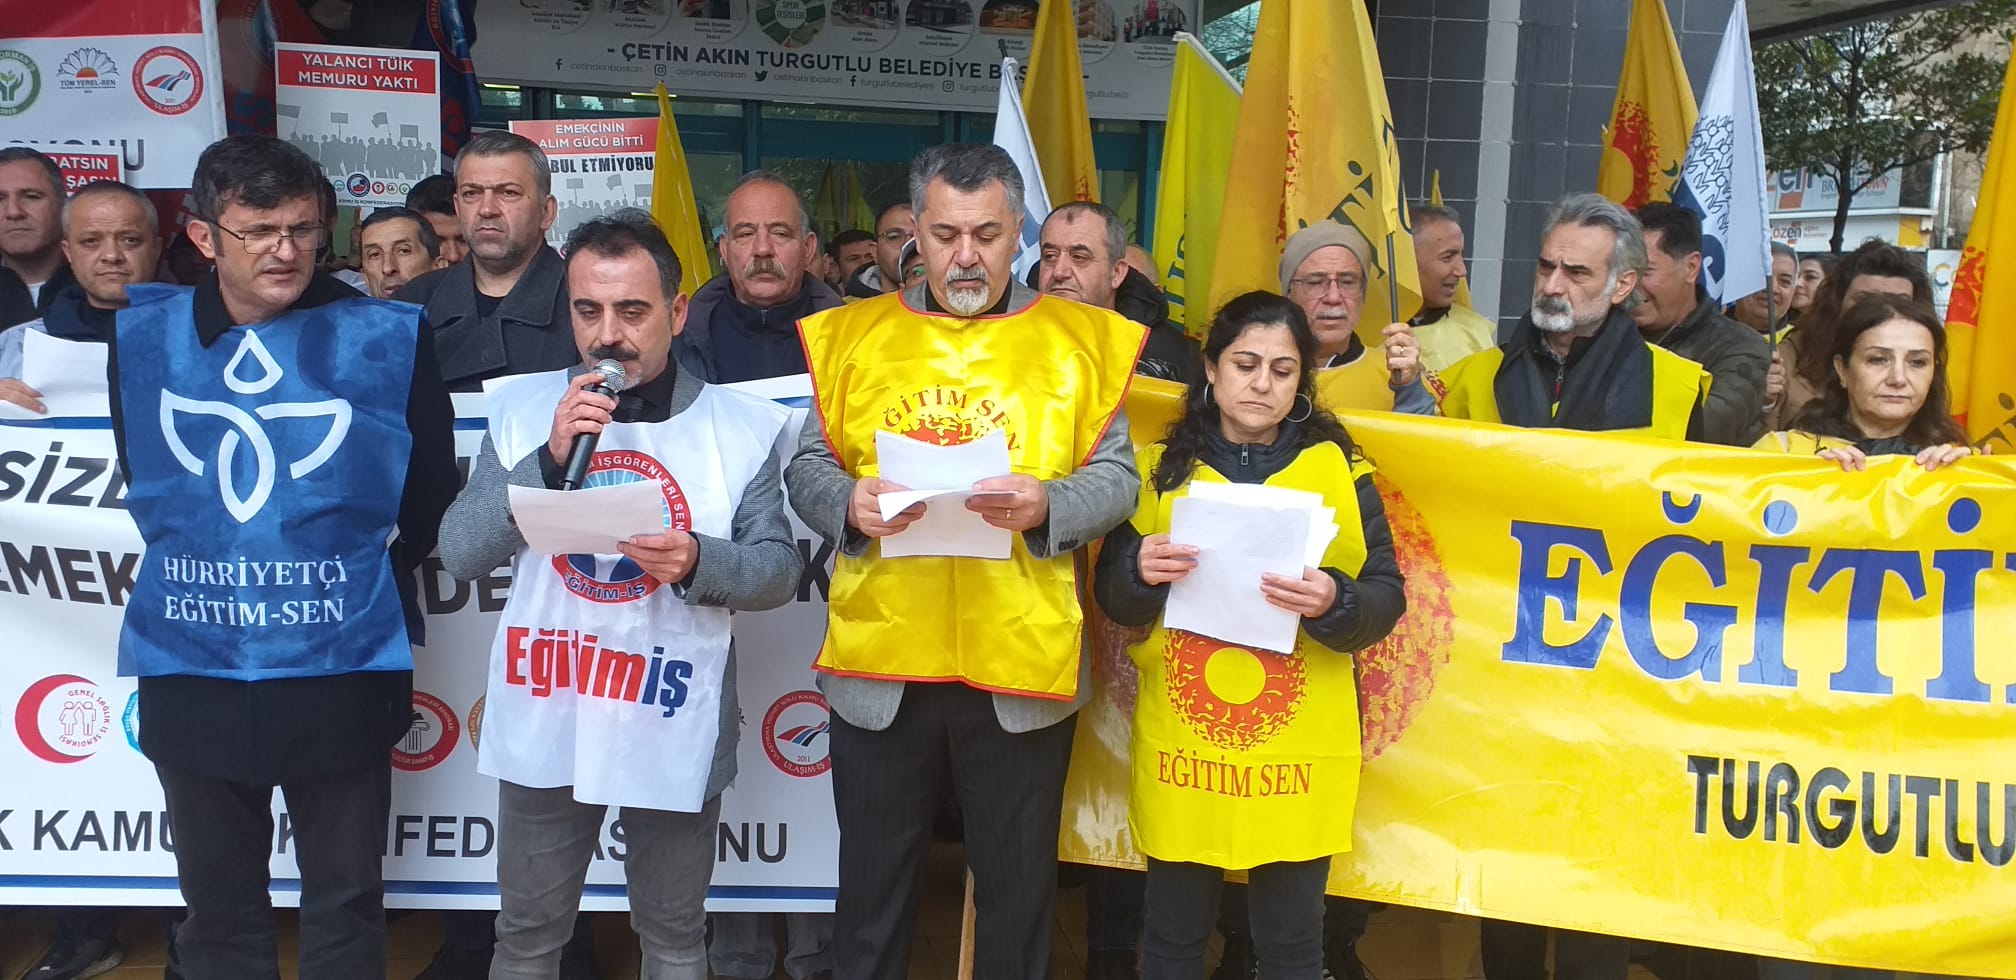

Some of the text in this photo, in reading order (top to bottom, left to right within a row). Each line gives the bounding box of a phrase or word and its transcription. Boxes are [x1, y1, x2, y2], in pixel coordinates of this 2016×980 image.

[302, 53, 413, 71] YALANCI TÜİK
[622, 42, 688, 61] ÇETİN
[695, 48, 749, 65] AKIN
[756, 51, 871, 72] TURGUTLU
[879, 58, 982, 79] BELEDİYE
[299, 71, 418, 89] MEMURU YAKTI
[540, 134, 644, 149] ALIM GÜCÜ BİTTİ
[556, 123, 624, 134] EMEKÇİNİN
[873, 384, 967, 443] ĞİTİM
[598, 454, 680, 500] İŞGÖRENLERİ
[164, 554, 348, 590] HÜRRİYETÇİ
[164, 592, 344, 626] EĞİTİM-SEN
[1502, 491, 2016, 704] EĞİTİ
[1158, 747, 1312, 797] EĞİTİM SEN
[1687, 755, 2016, 866] TURGUTLU
